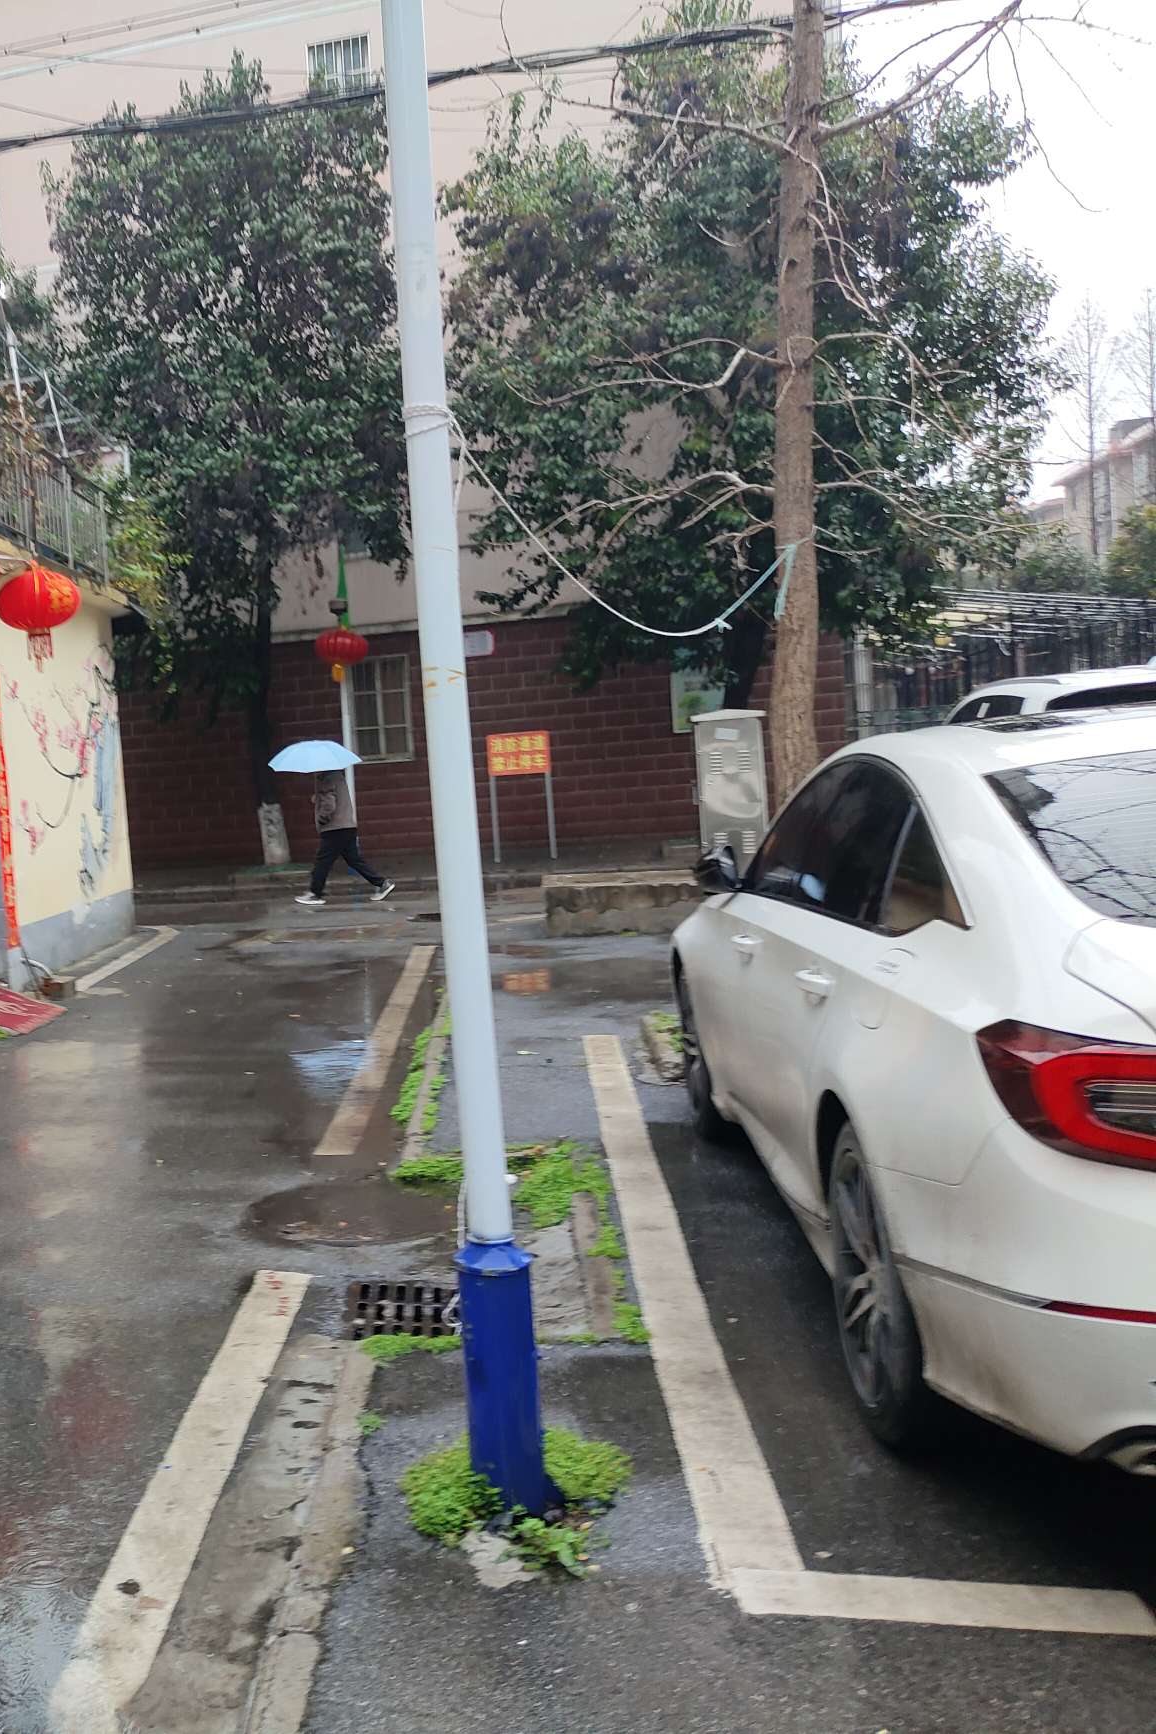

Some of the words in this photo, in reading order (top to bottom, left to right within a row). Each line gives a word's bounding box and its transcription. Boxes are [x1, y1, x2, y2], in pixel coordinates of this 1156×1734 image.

[491, 735, 545, 753] 消防通道
[491, 754, 547, 772] 禁止停车
